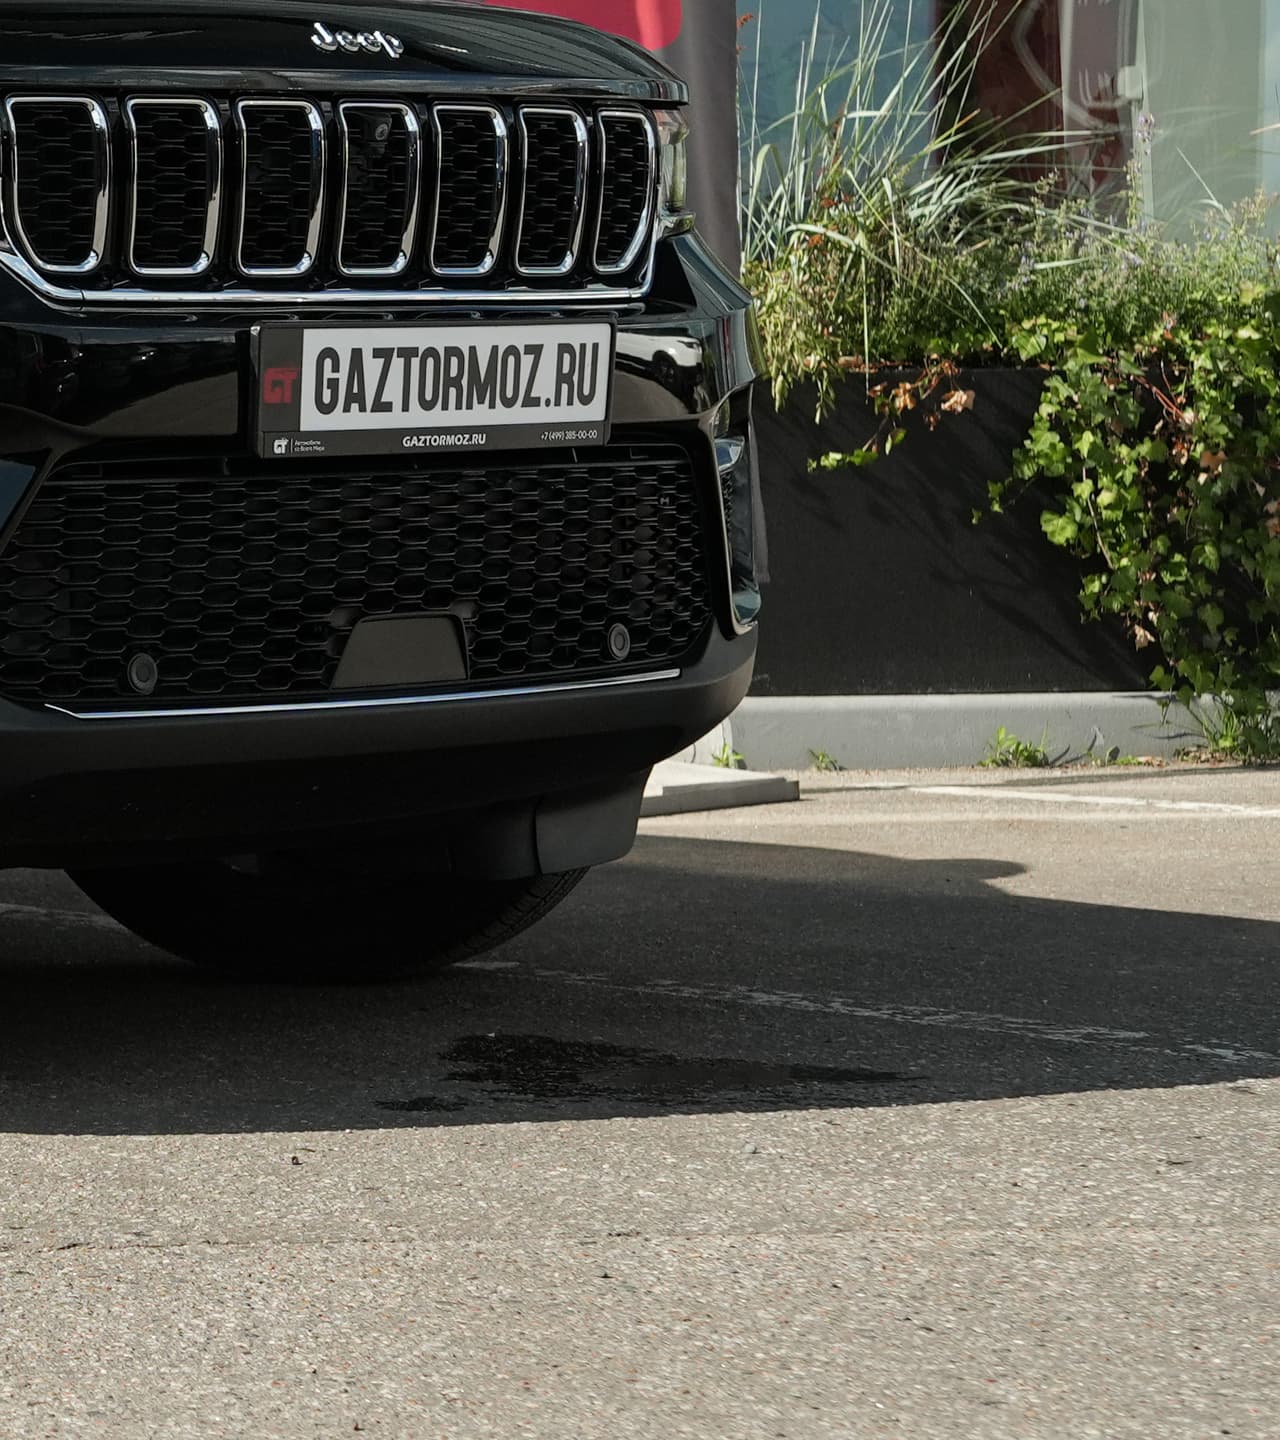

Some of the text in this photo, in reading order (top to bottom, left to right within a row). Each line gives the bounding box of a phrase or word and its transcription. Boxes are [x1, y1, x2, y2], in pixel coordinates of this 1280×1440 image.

[310, 22, 405, 59] Jeep
[313, 341, 600, 415] GAZTORMOZ.RU
[402, 432, 487, 449] GAZTORMOZ.RU
